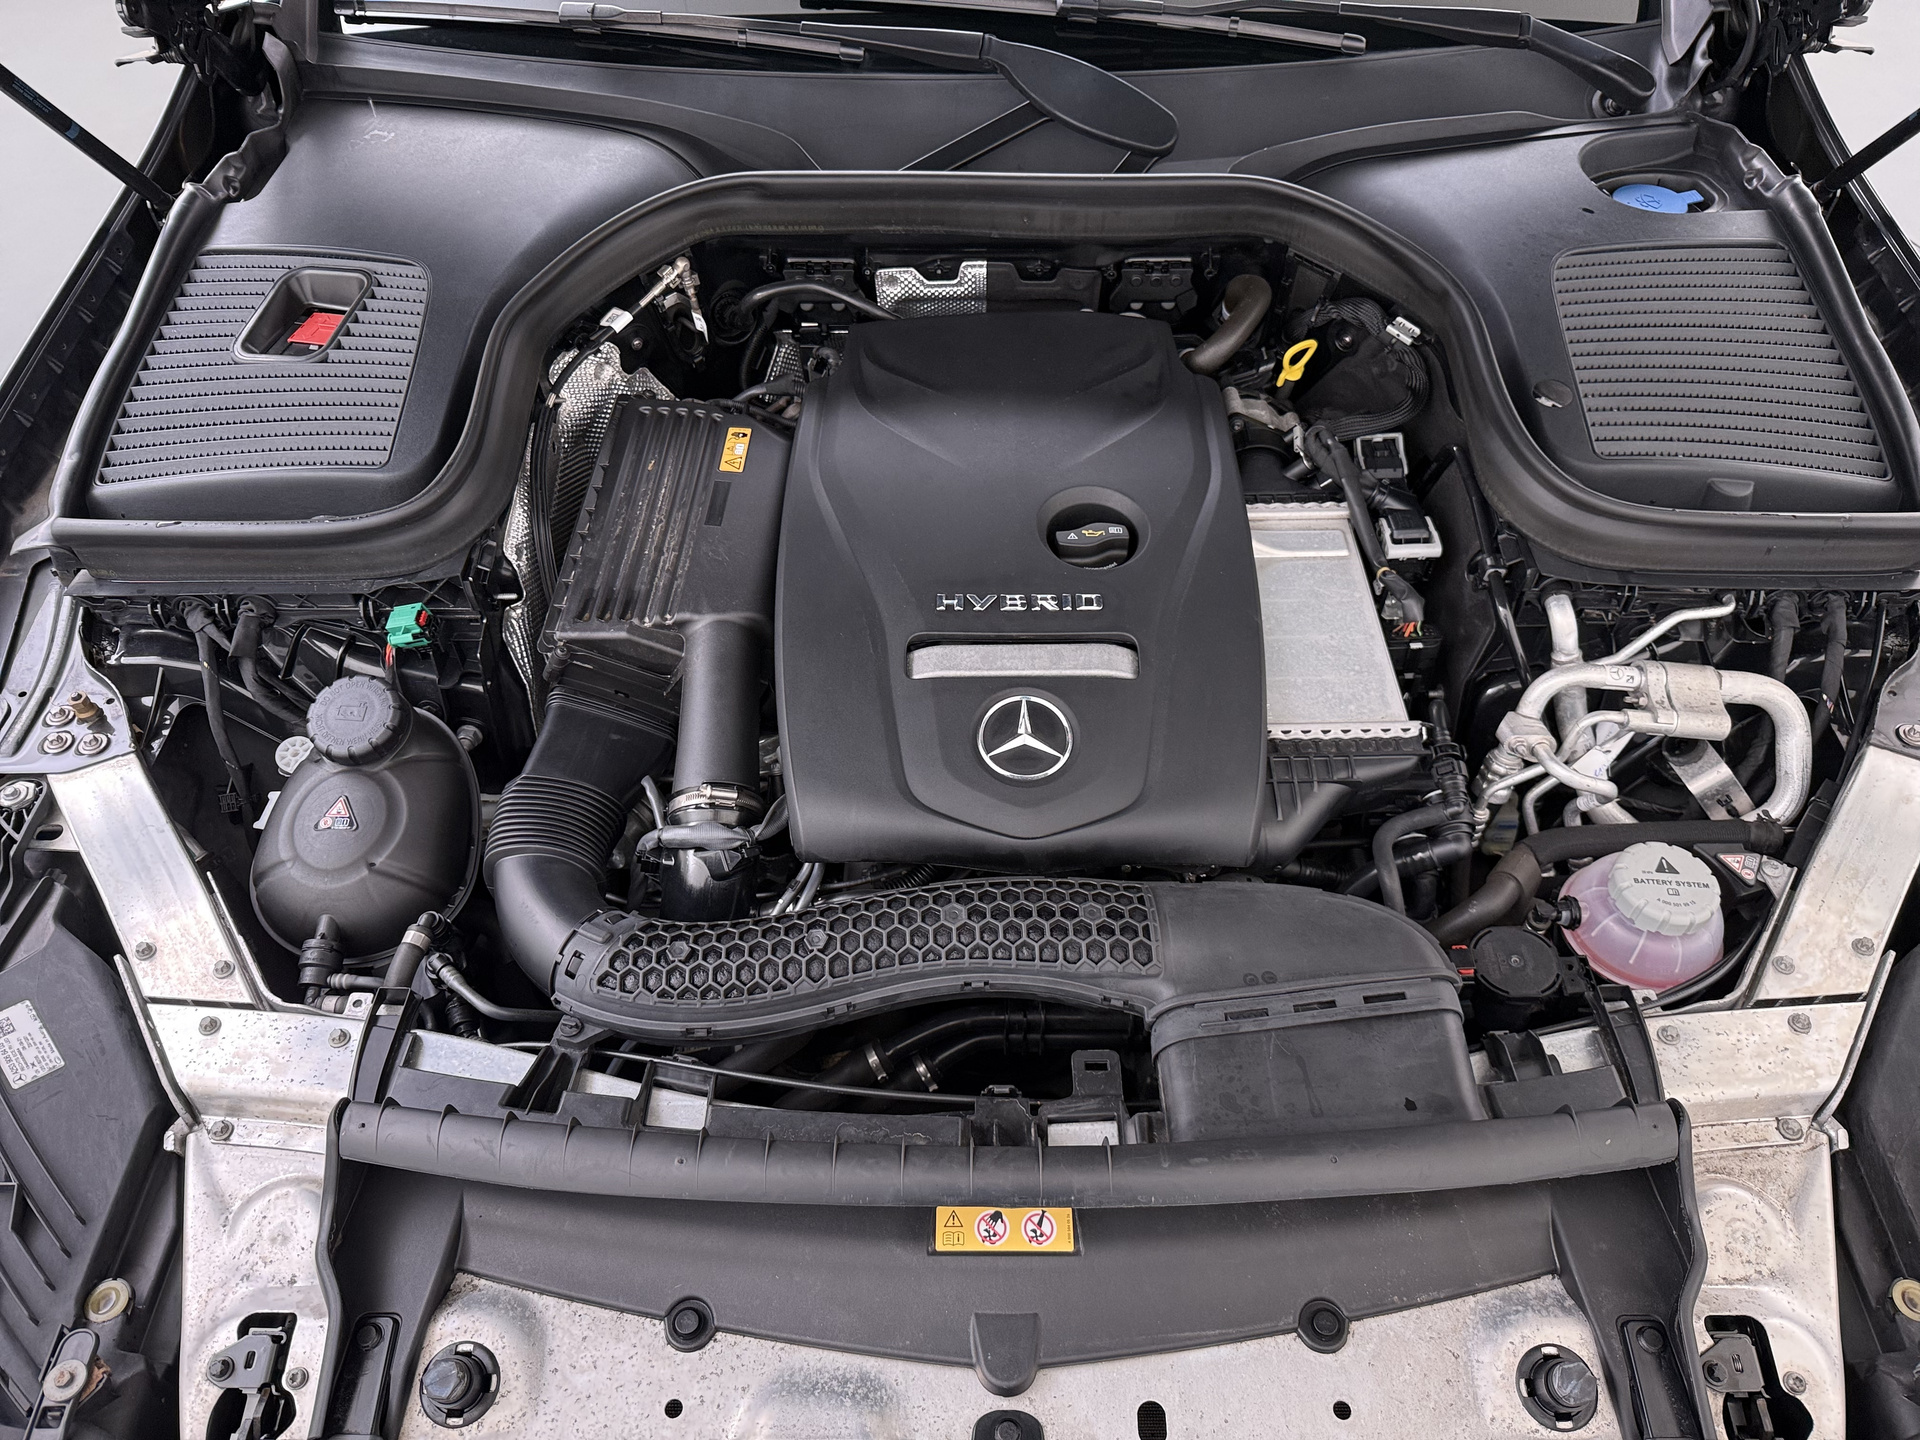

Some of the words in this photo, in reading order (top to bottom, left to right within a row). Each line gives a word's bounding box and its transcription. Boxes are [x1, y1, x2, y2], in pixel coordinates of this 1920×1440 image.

[936, 593, 1104, 611] HYBRID
[345, 681, 366, 690] OPEN
[1633, 877, 1673, 887] BATTERY
[1674, 880, 1710, 889] SYSTEM
